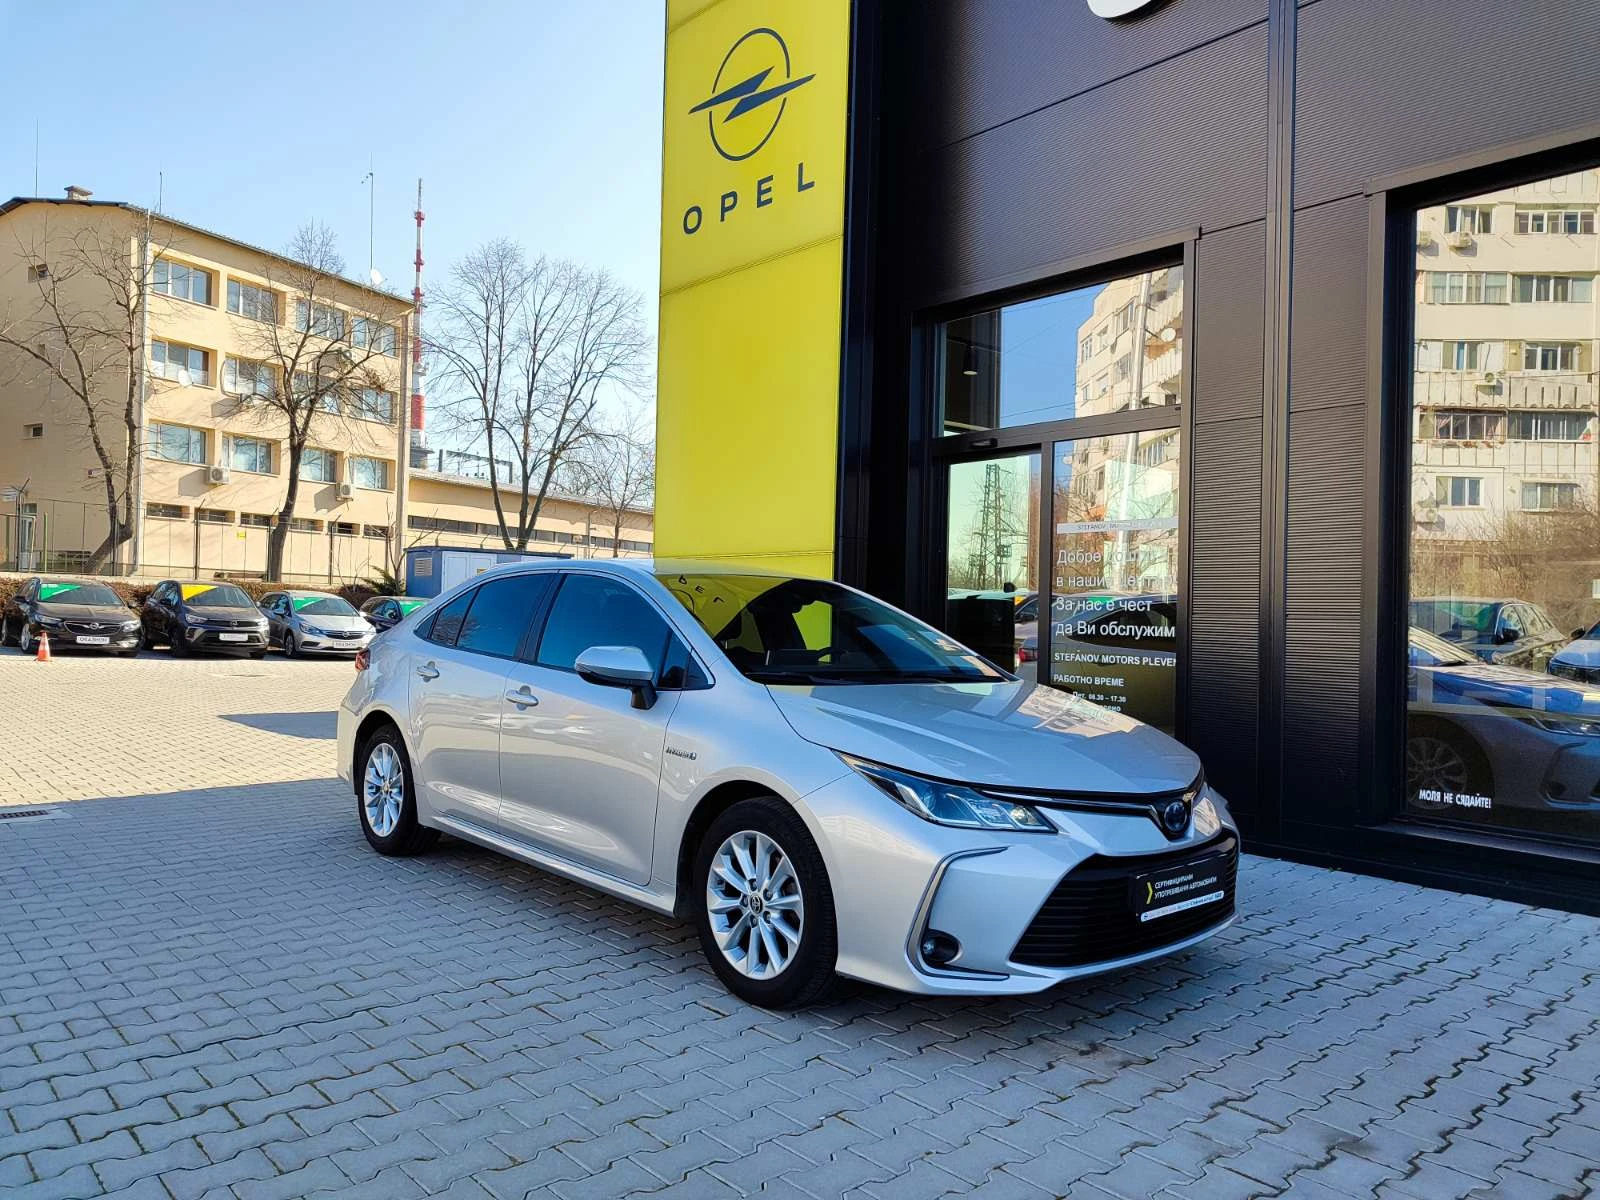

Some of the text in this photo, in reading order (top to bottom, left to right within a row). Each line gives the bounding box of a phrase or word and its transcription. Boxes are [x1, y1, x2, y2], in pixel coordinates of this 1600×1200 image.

[683, 162, 815, 234] OPEL
[1057, 549, 1102, 566] Добре
[1056, 576, 1064, 587] в
[1069, 576, 1112, 587] наши
[1056, 597, 1153, 612] За нас е чест
[1056, 621, 1175, 640] да Ви обслужим
[1054, 652, 1100, 663] STEFANOV
[1101, 654, 1140, 665] MOTORS
[1053, 674, 1125, 687] РАБОТНО ВРЕМЕ
[1419, 788, 1492, 809] МОЛЯ НЕ СЯДАЙТЕ!
